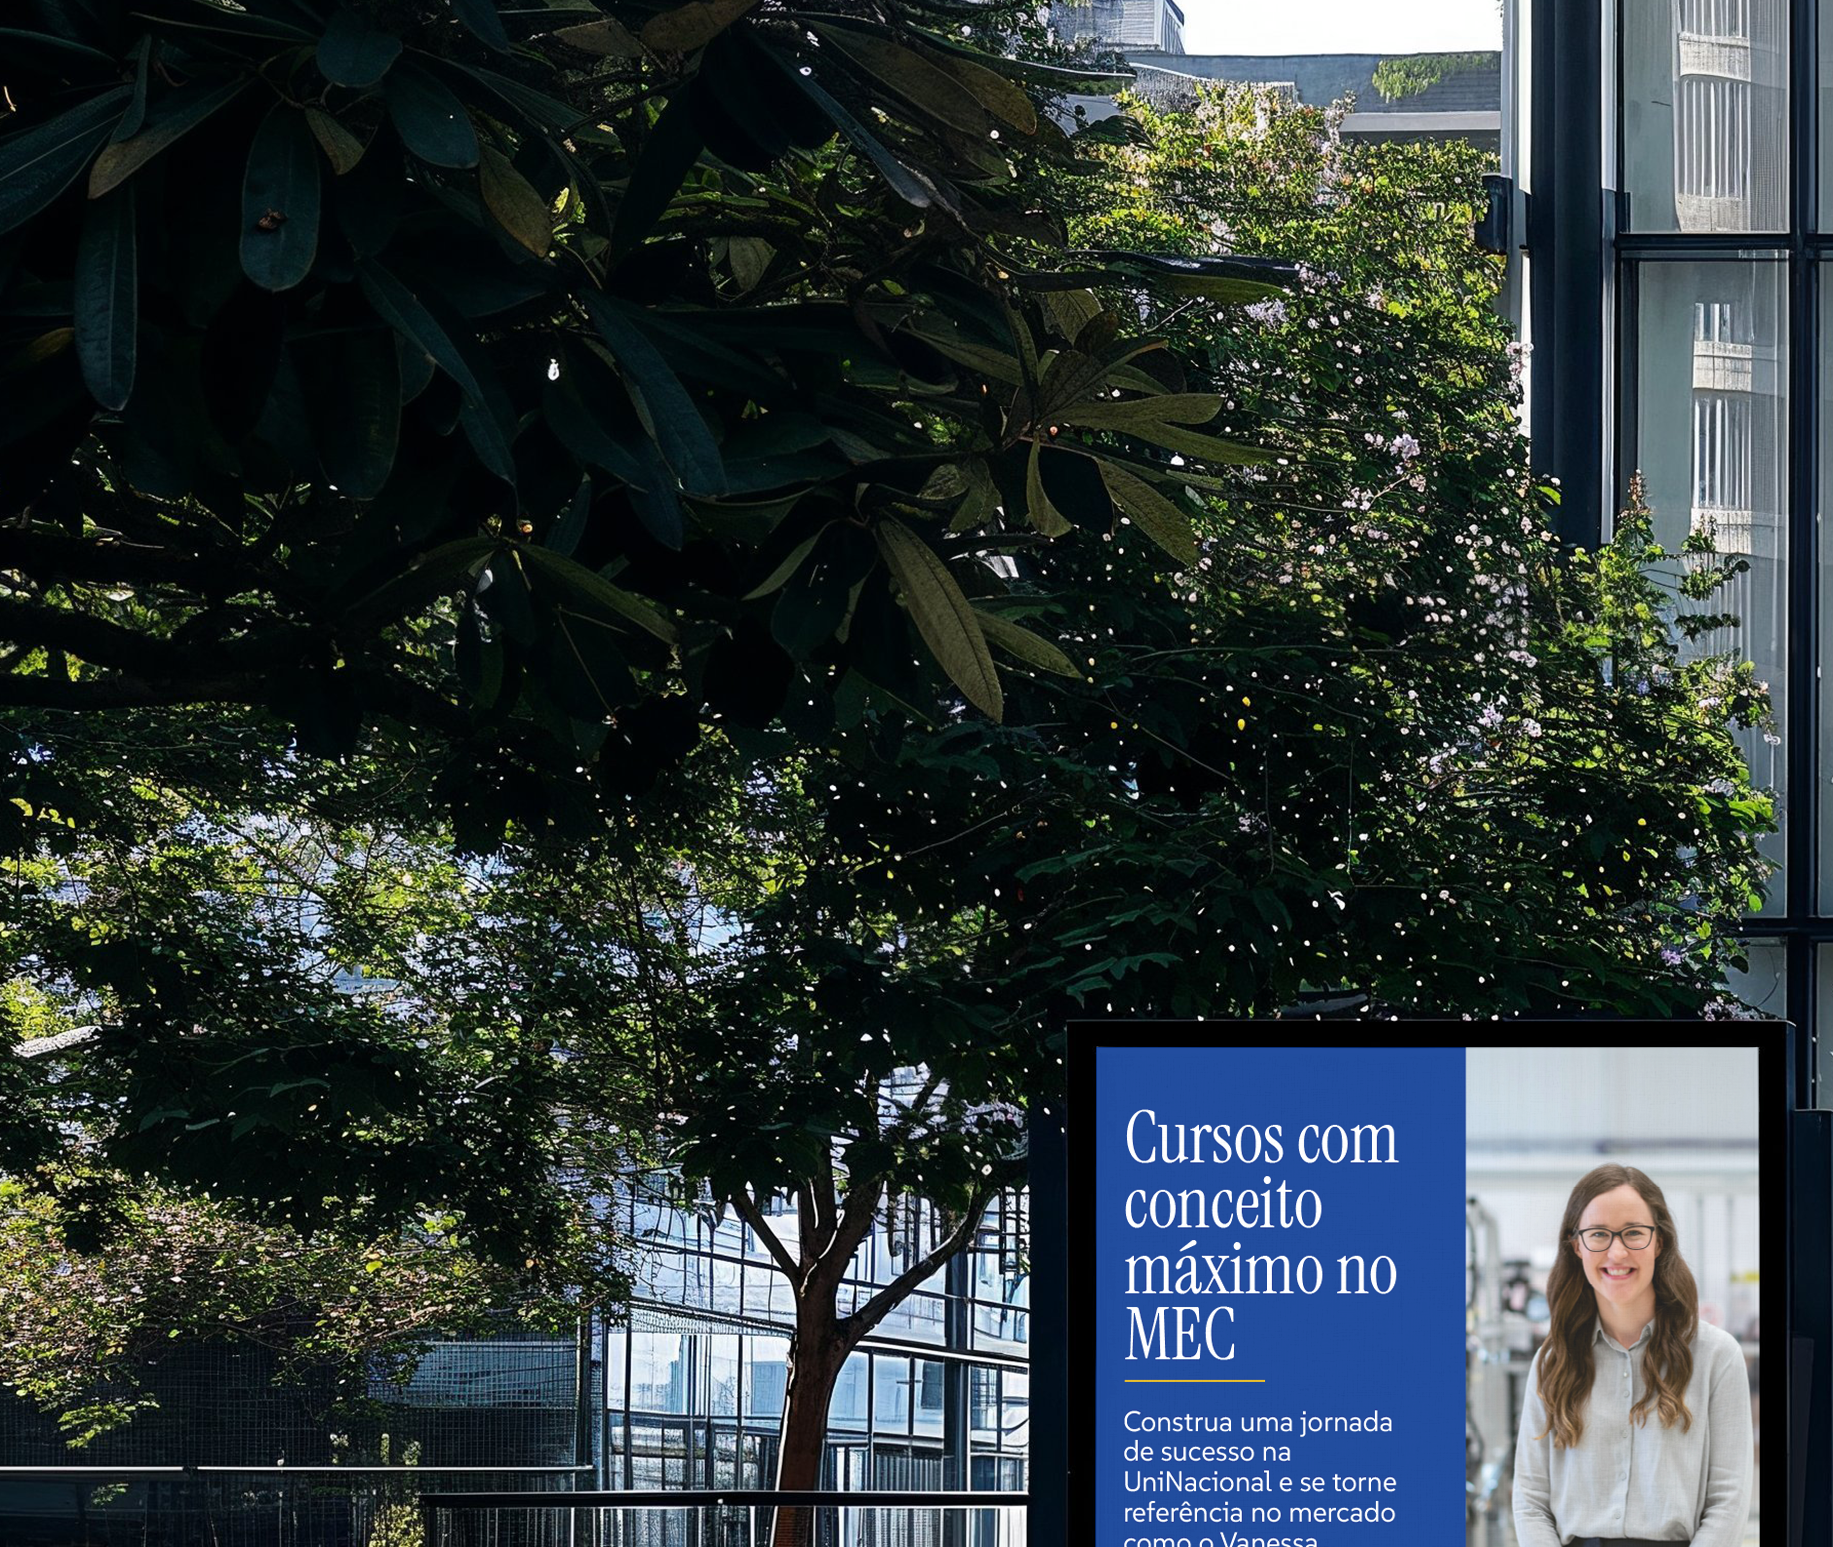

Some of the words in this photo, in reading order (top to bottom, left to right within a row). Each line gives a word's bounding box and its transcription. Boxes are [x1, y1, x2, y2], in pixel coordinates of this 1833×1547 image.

[1126, 1109, 1284, 1164] Cursos
[1298, 1124, 1400, 1164] com
[1125, 1175, 1322, 1229] conceito
[1124, 1239, 1323, 1295] máximo
[1336, 1255, 1397, 1295] no
[1124, 1306, 1235, 1361] MEC
[1124, 1410, 1232, 1433] Construa
[1241, 1416, 1293, 1432] uma
[1299, 1409, 1392, 1438] jornada
[1123, 1439, 1154, 1462] de
[1161, 1446, 1255, 1462] sucesso
[1263, 1446, 1291, 1462] na
[1124, 1469, 1273, 1492] UniNacional
[1279, 1476, 1293, 1492] e
[1300, 1476, 1326, 1492] se
[1332, 1473, 1397, 1492] torne
[1124, 1500, 1243, 1523] referência
[1252, 1507, 1282, 1523] no
[1289, 1500, 1396, 1523] mercado
